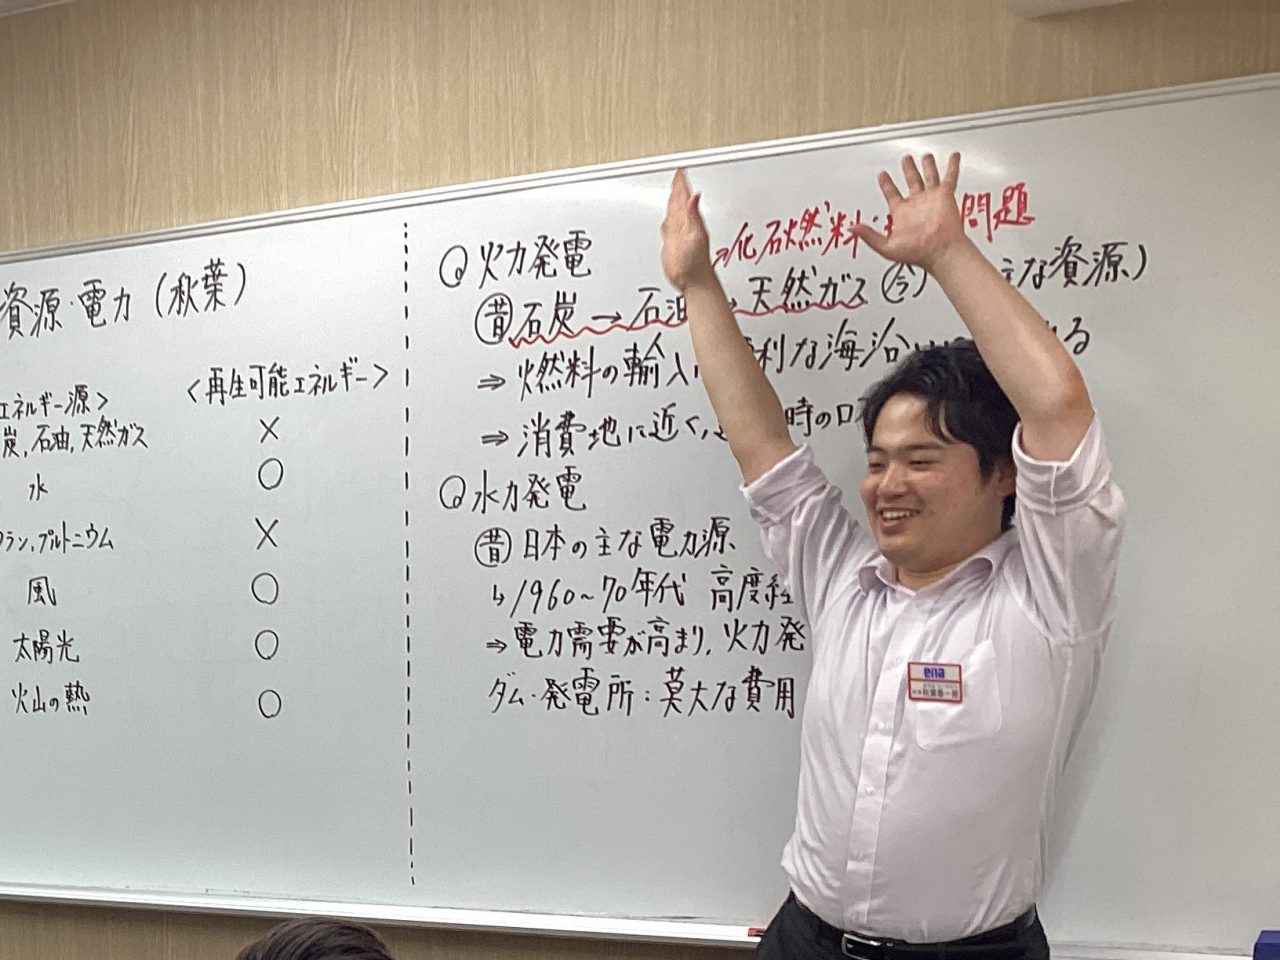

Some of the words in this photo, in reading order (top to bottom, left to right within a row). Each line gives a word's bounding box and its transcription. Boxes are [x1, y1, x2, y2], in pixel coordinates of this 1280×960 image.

[12, 629, 80, 665] 太陽光
[923, 667, 945, 679] ena
